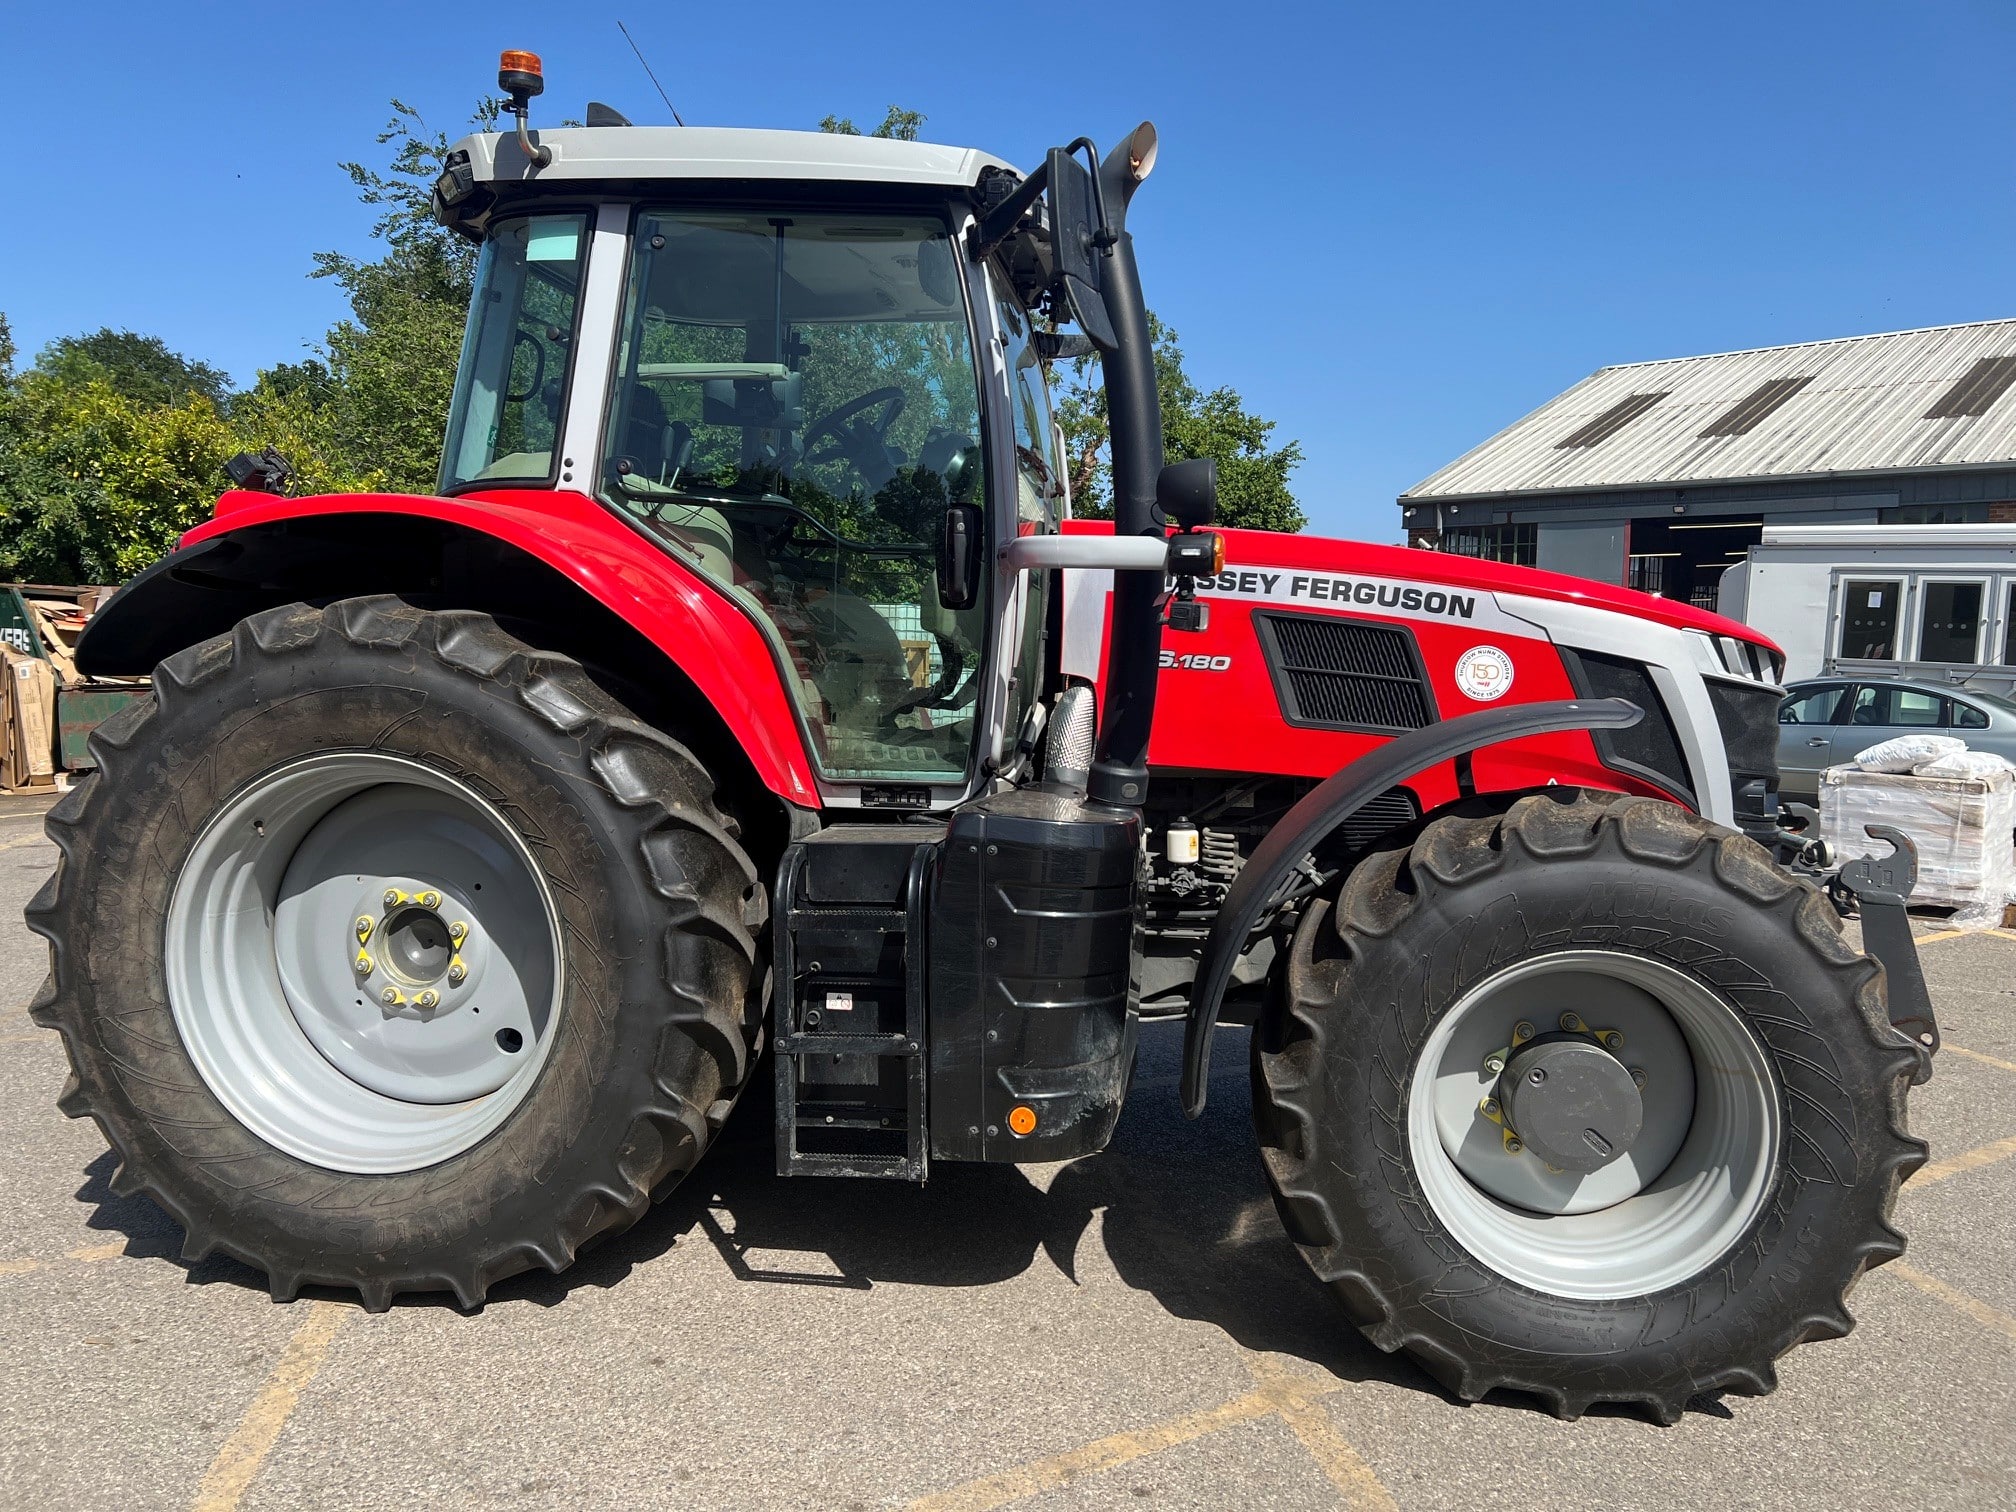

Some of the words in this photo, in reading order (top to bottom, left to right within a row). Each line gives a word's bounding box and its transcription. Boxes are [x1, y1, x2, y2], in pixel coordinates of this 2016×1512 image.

[1165, 571, 1281, 595] SSEY
[1290, 576, 1476, 619] FERGUSON
[1459, 652, 1476, 676] THURLOW
[1497, 654, 1510, 680] STANDEN
[1470, 663, 1500, 680] 150
[1466, 687, 1485, 697] SINCE
[1486, 689, 1500, 697] 1875
[145, 743, 184, 785] 38
[1569, 881, 1736, 938] Mitas
